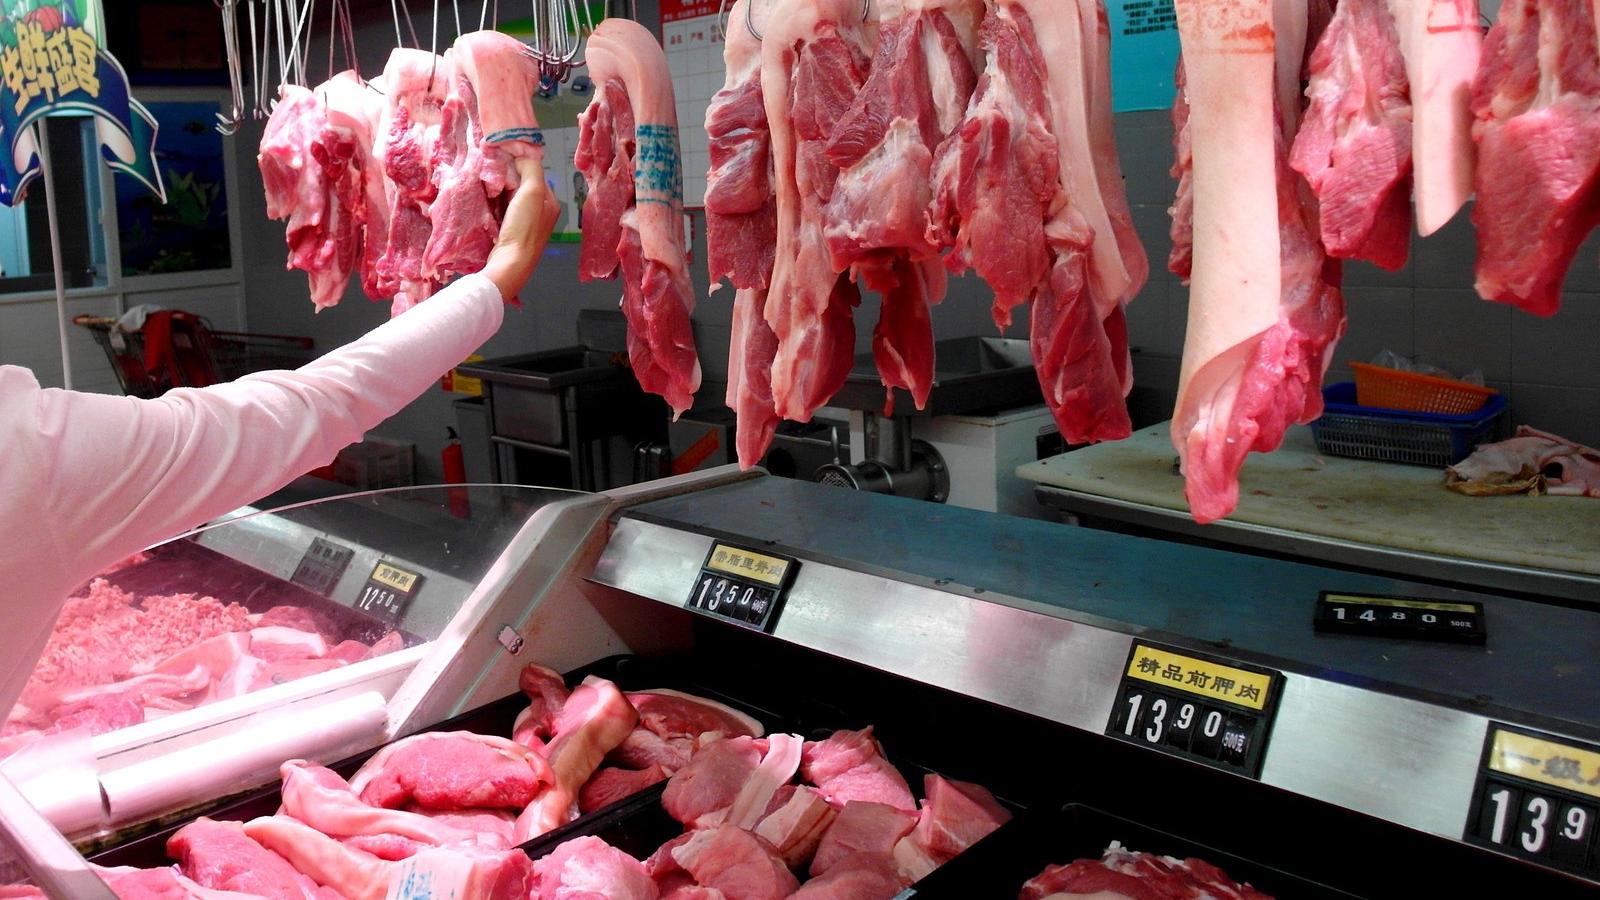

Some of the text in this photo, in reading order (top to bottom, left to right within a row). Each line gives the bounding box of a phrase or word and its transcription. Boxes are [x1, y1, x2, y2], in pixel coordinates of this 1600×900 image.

[1136, 656, 1261, 703] 精品前胛肉
